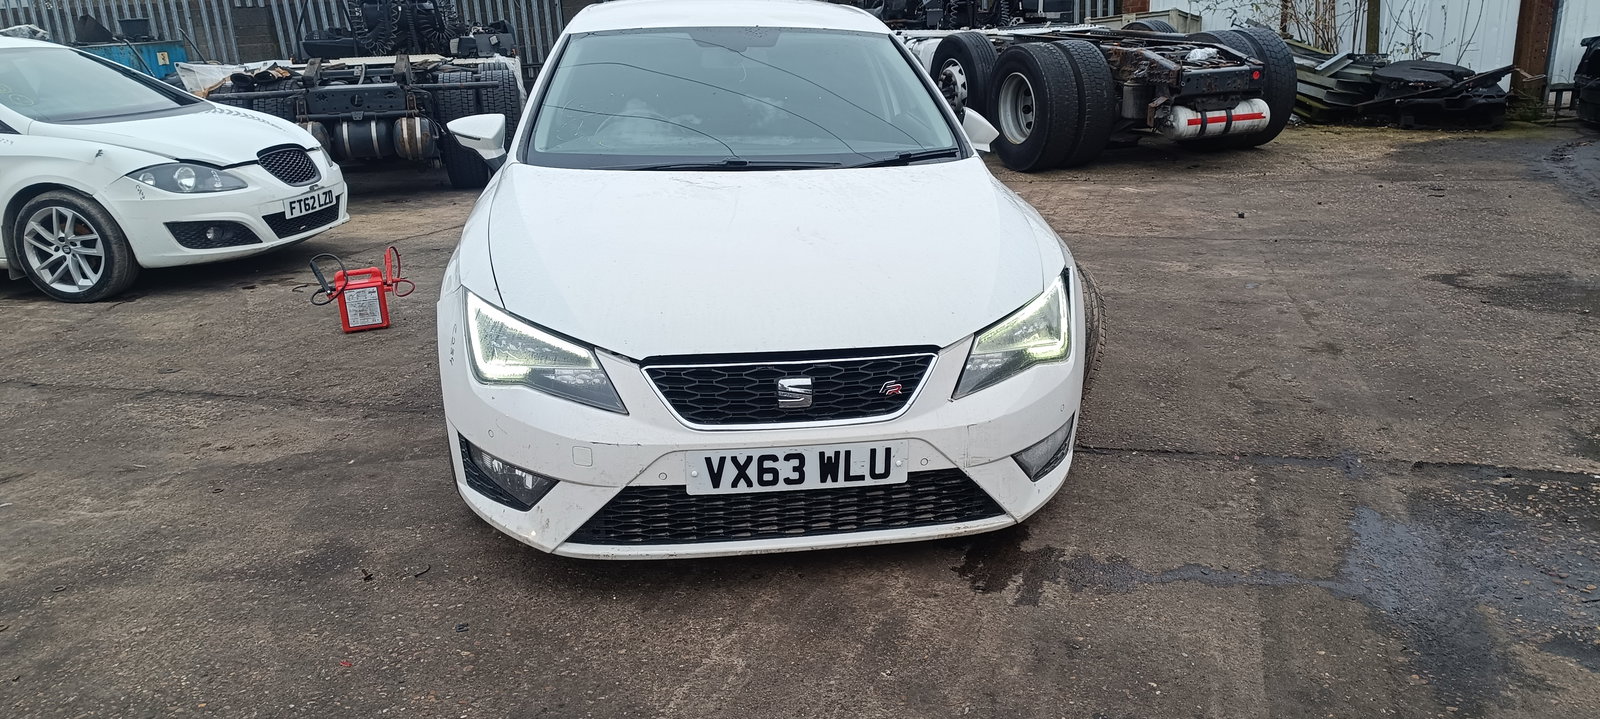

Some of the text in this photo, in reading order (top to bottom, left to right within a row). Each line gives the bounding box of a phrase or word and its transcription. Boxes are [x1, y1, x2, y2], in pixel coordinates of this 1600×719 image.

[289, 190, 334, 216] FT62 LZD
[878, 380, 903, 396] FR
[704, 446, 892, 489] VX63 WLU
